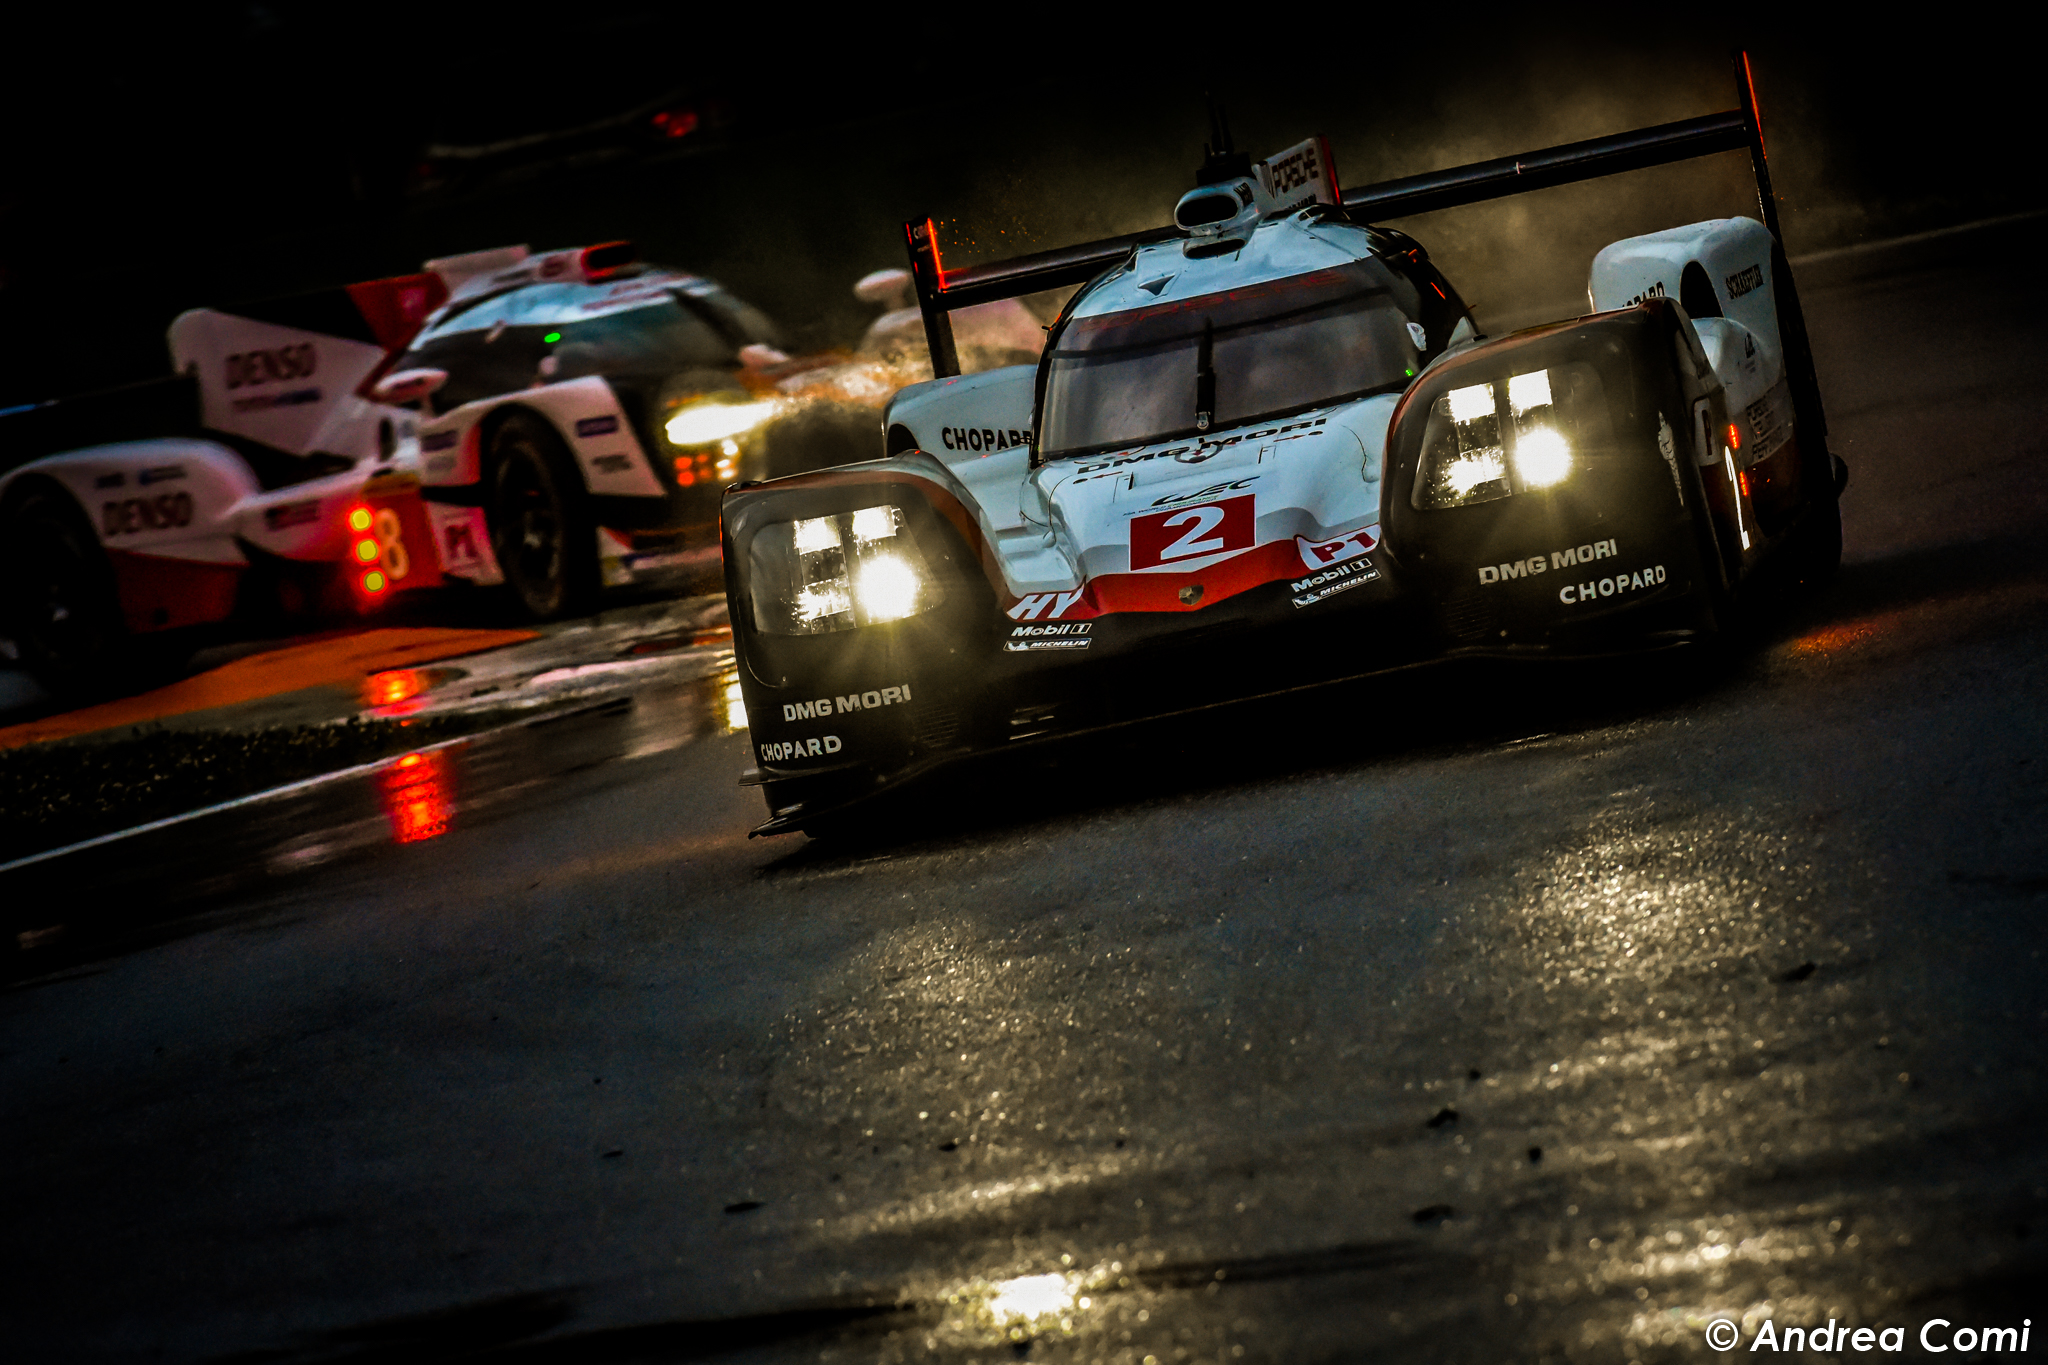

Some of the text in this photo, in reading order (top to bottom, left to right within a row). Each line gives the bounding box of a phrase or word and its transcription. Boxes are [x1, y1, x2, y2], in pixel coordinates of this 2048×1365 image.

[225, 342, 318, 389] DENSO
[1077, 418, 1327, 474] DMG MORI
[103, 492, 194, 536] DENSO
[1160, 506, 1225, 560] 2
[374, 507, 410, 580] 8
[1310, 532, 1377, 563] P1
[1478, 538, 1618, 585] DMG MORI
[1291, 565, 1351, 592] Mobil
[1320, 571, 1377, 596] MICHELIN
[1559, 565, 1667, 605] CHOPARD
[1006, 583, 1085, 620] HY
[1011, 624, 1071, 636] Mobil
[1030, 640, 1088, 648] MICHELIN
[783, 684, 912, 722] DMG MORI
[761, 735, 842, 762] CHOPARD
